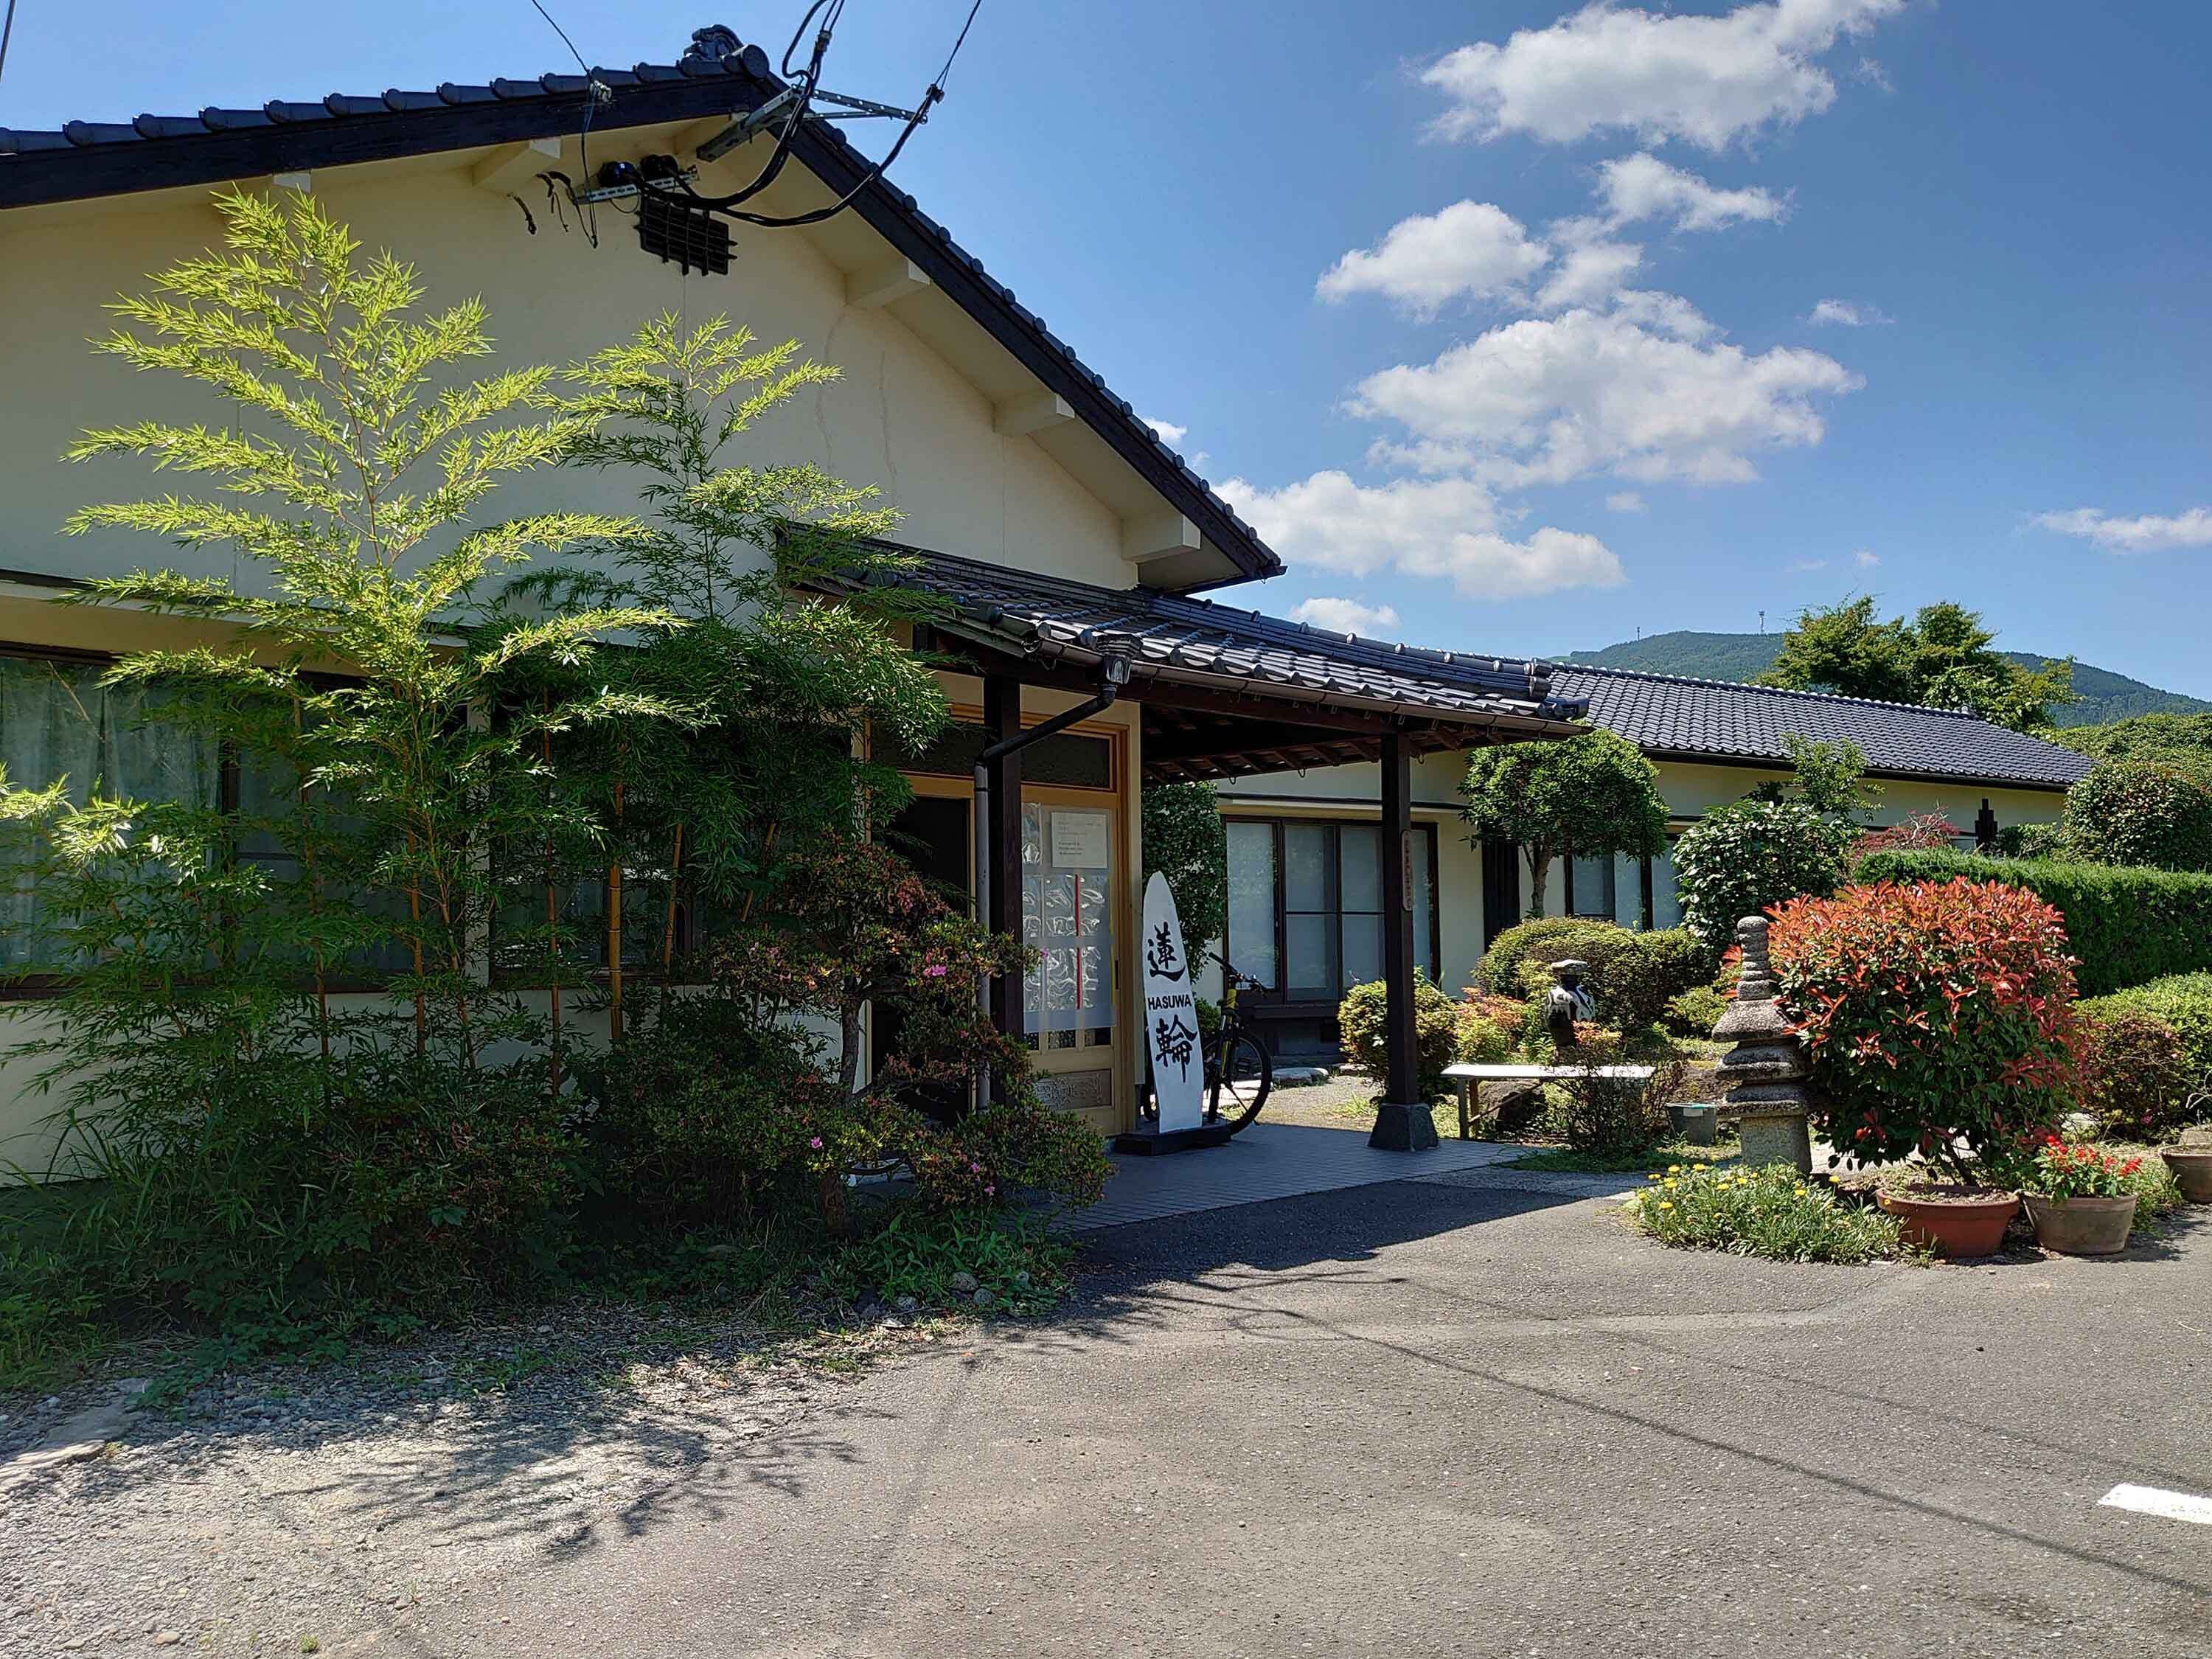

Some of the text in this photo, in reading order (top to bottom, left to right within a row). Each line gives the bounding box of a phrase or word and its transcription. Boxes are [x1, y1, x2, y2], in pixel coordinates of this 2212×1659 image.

[1147, 922, 1186, 982] 蓮
[1147, 994, 1192, 1011] HASUWA
[1155, 1014, 1197, 1083] 輪
